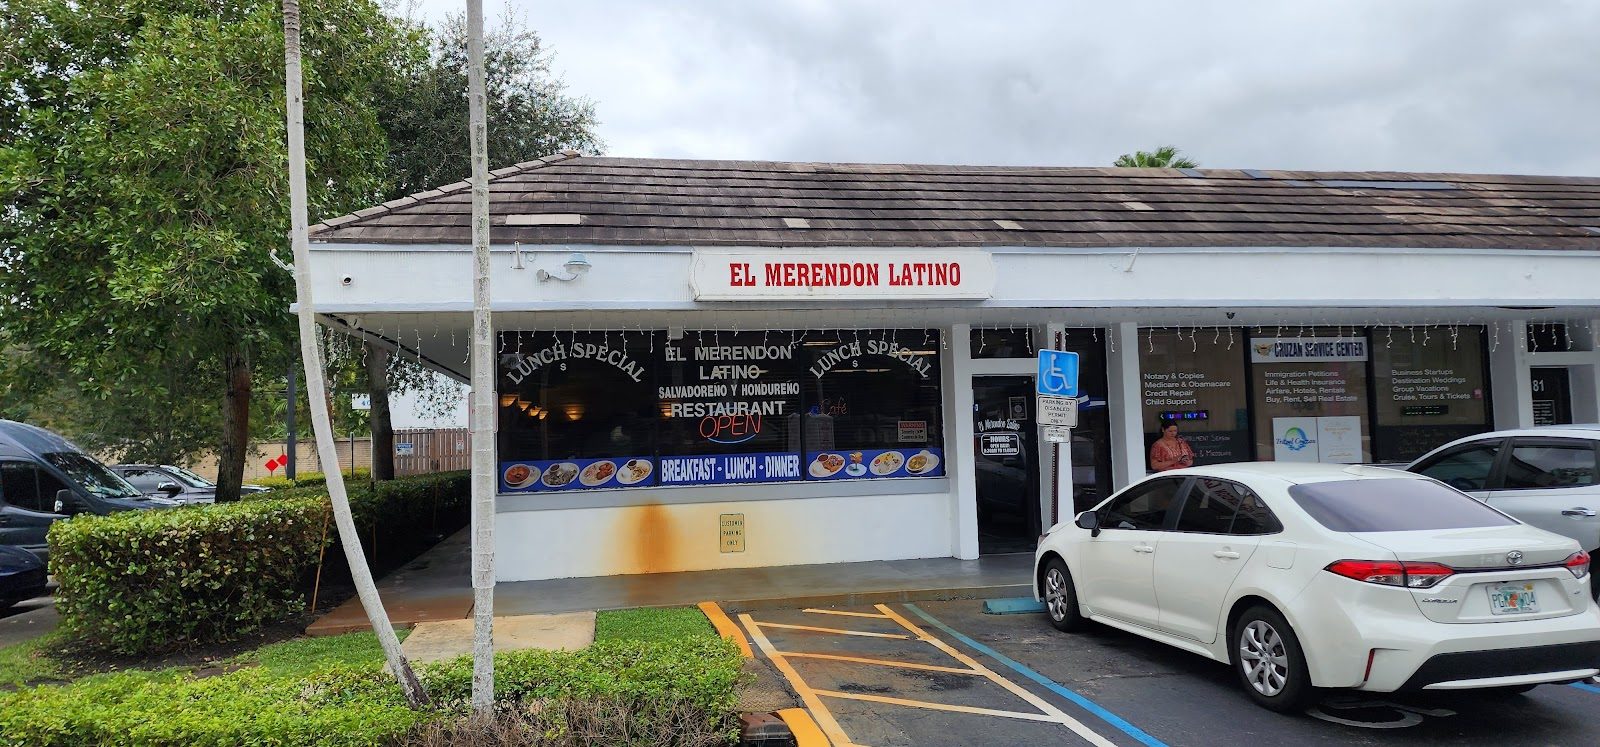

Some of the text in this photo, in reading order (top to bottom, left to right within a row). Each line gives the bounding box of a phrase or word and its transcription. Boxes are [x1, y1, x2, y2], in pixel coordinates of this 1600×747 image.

[729, 262, 961, 287] EL MERENDON LATINO
[665, 345, 792, 361] EL MERENDON
[1274, 341, 1364, 358] CRUZAN SERVICE CENTER
[506, 342, 646, 385] LUNCH SPECIAL
[809, 340, 932, 379] LUNCH SPECIAL
[699, 365, 760, 380] LATINO
[1264, 371, 1307, 379] Immigration
[1424, 368, 1454, 376] Startups
[1188, 380, 1231, 388] Obamacare
[1432, 377, 1466, 385] Weddings
[1532, 379, 1545, 392] 81
[731, 383, 738, 396] Y
[1169, 389, 1194, 397] Repair
[1446, 392, 1471, 400] Tickets
[670, 401, 787, 418] RESTAURANT
[700, 413, 763, 438] OPEN
[989, 435, 1010, 443] HOURS
[661, 454, 800, 482] BREAKFAST LUNCH DINNER
